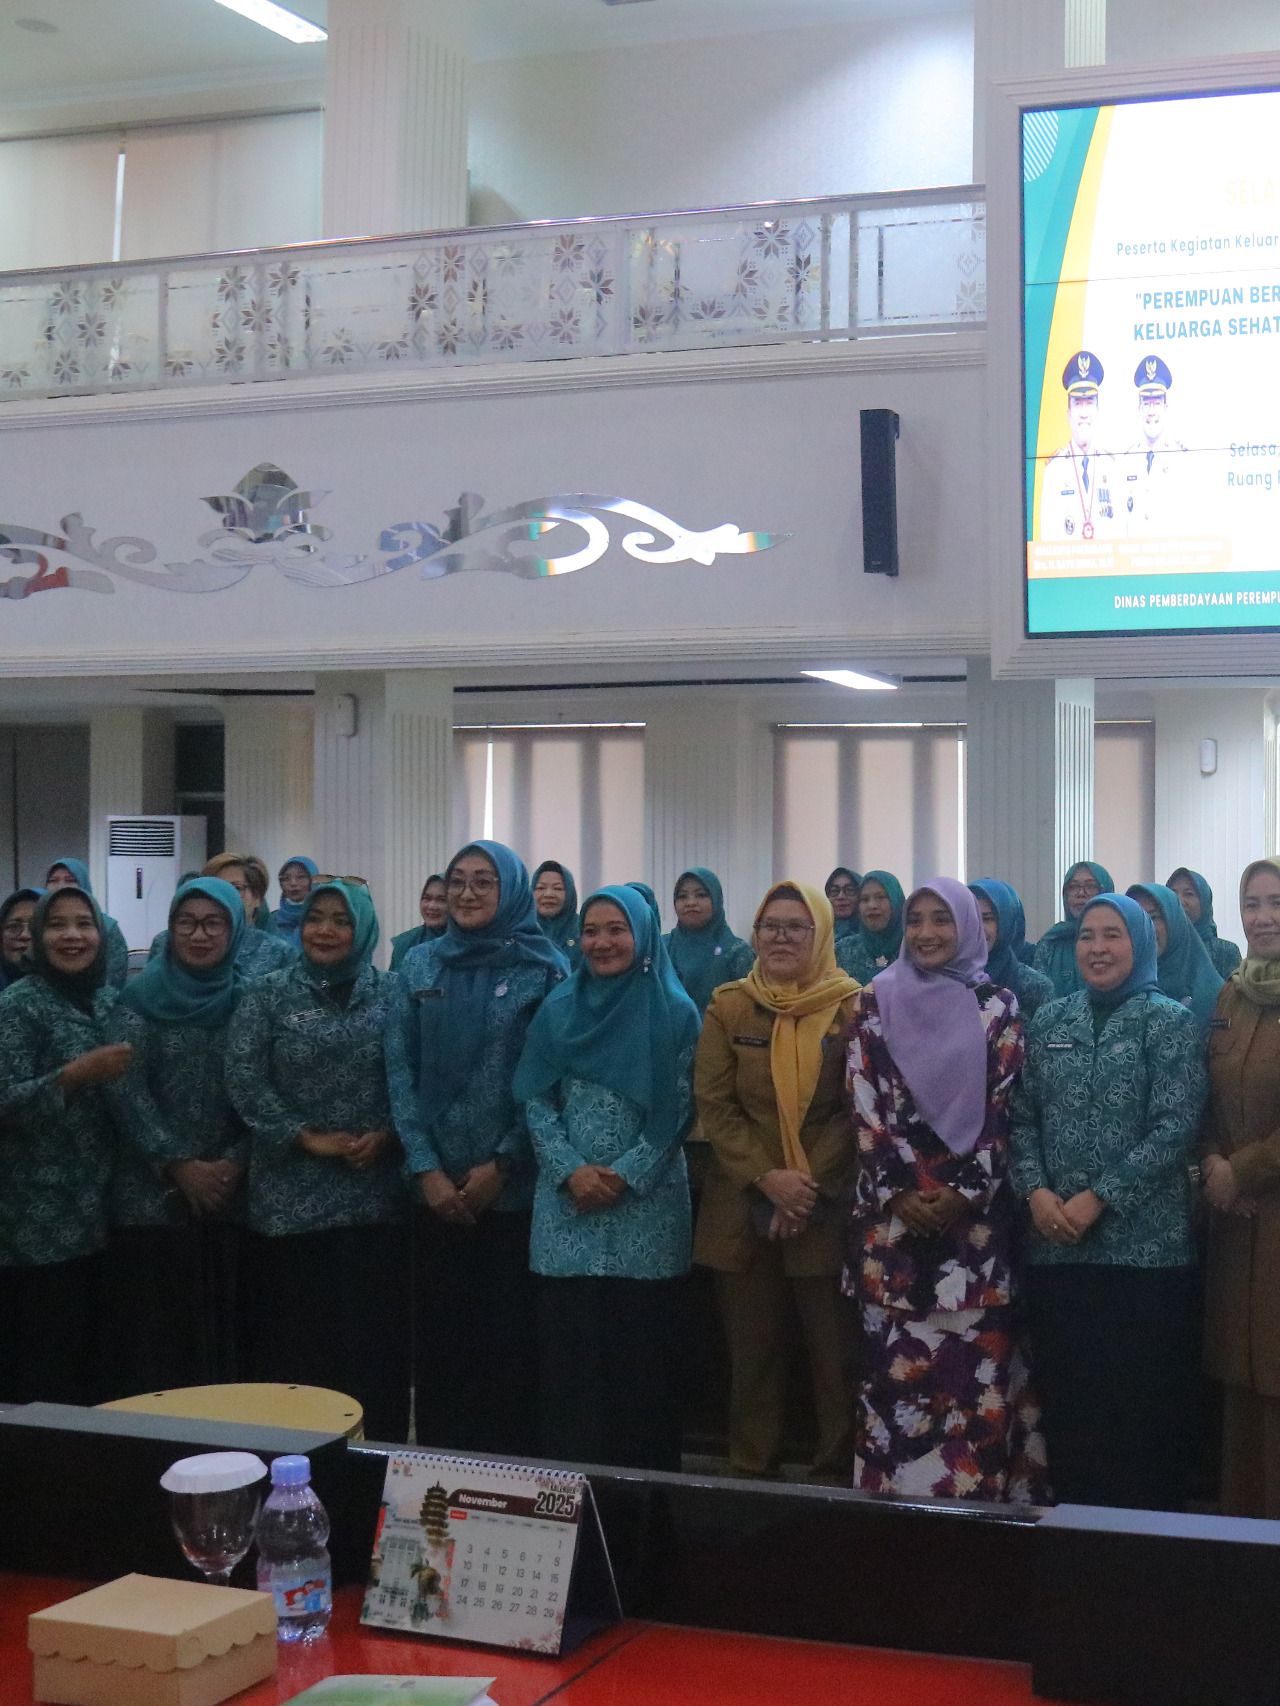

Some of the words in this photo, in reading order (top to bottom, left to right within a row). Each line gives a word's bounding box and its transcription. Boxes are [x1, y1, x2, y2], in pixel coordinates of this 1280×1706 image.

[1117, 241, 1166, 256] Peserta
[1171, 236, 1230, 256] Kegiatan
[1136, 287, 1244, 310] "PEREMPUAN
[1134, 319, 1222, 341] KELUARGA
[1230, 441, 1280, 458] Selasa,
[1228, 471, 1272, 490] Ruang
[1114, 594, 1146, 609] DINAS
[1149, 592, 1233, 608] PEMBERDAYAAN
[459, 1493, 508, 1509] November
[535, 1490, 577, 1517] 2025
[467, 1544, 473, 1554] 3
[484, 1547, 491, 1556] 4
[502, 1549, 509, 1559] 5
[519, 1551, 526, 1562] 6
[537, 1554, 543, 1563] 7
[463, 1560, 472, 1570] 10
[482, 1562, 488, 1573] 11
[498, 1566, 507, 1576] 12
[516, 1568, 525, 1578] 13
[532, 1570, 541, 1581] 14
[550, 1573, 559, 1584] 15
[461, 1578, 469, 1588] 17
[478, 1580, 487, 1591] 18
[496, 1583, 504, 1593] 19
[512, 1586, 523, 1597] 20
[530, 1588, 538, 1599] 21
[547, 1591, 558, 1602] 22
[456, 1594, 468, 1605] 24
[473, 1597, 485, 1608] 25
[491, 1600, 502, 1610] 26
[509, 1602, 520, 1613] 27
[525, 1605, 537, 1616] 28
[543, 1607, 555, 1618] 29
